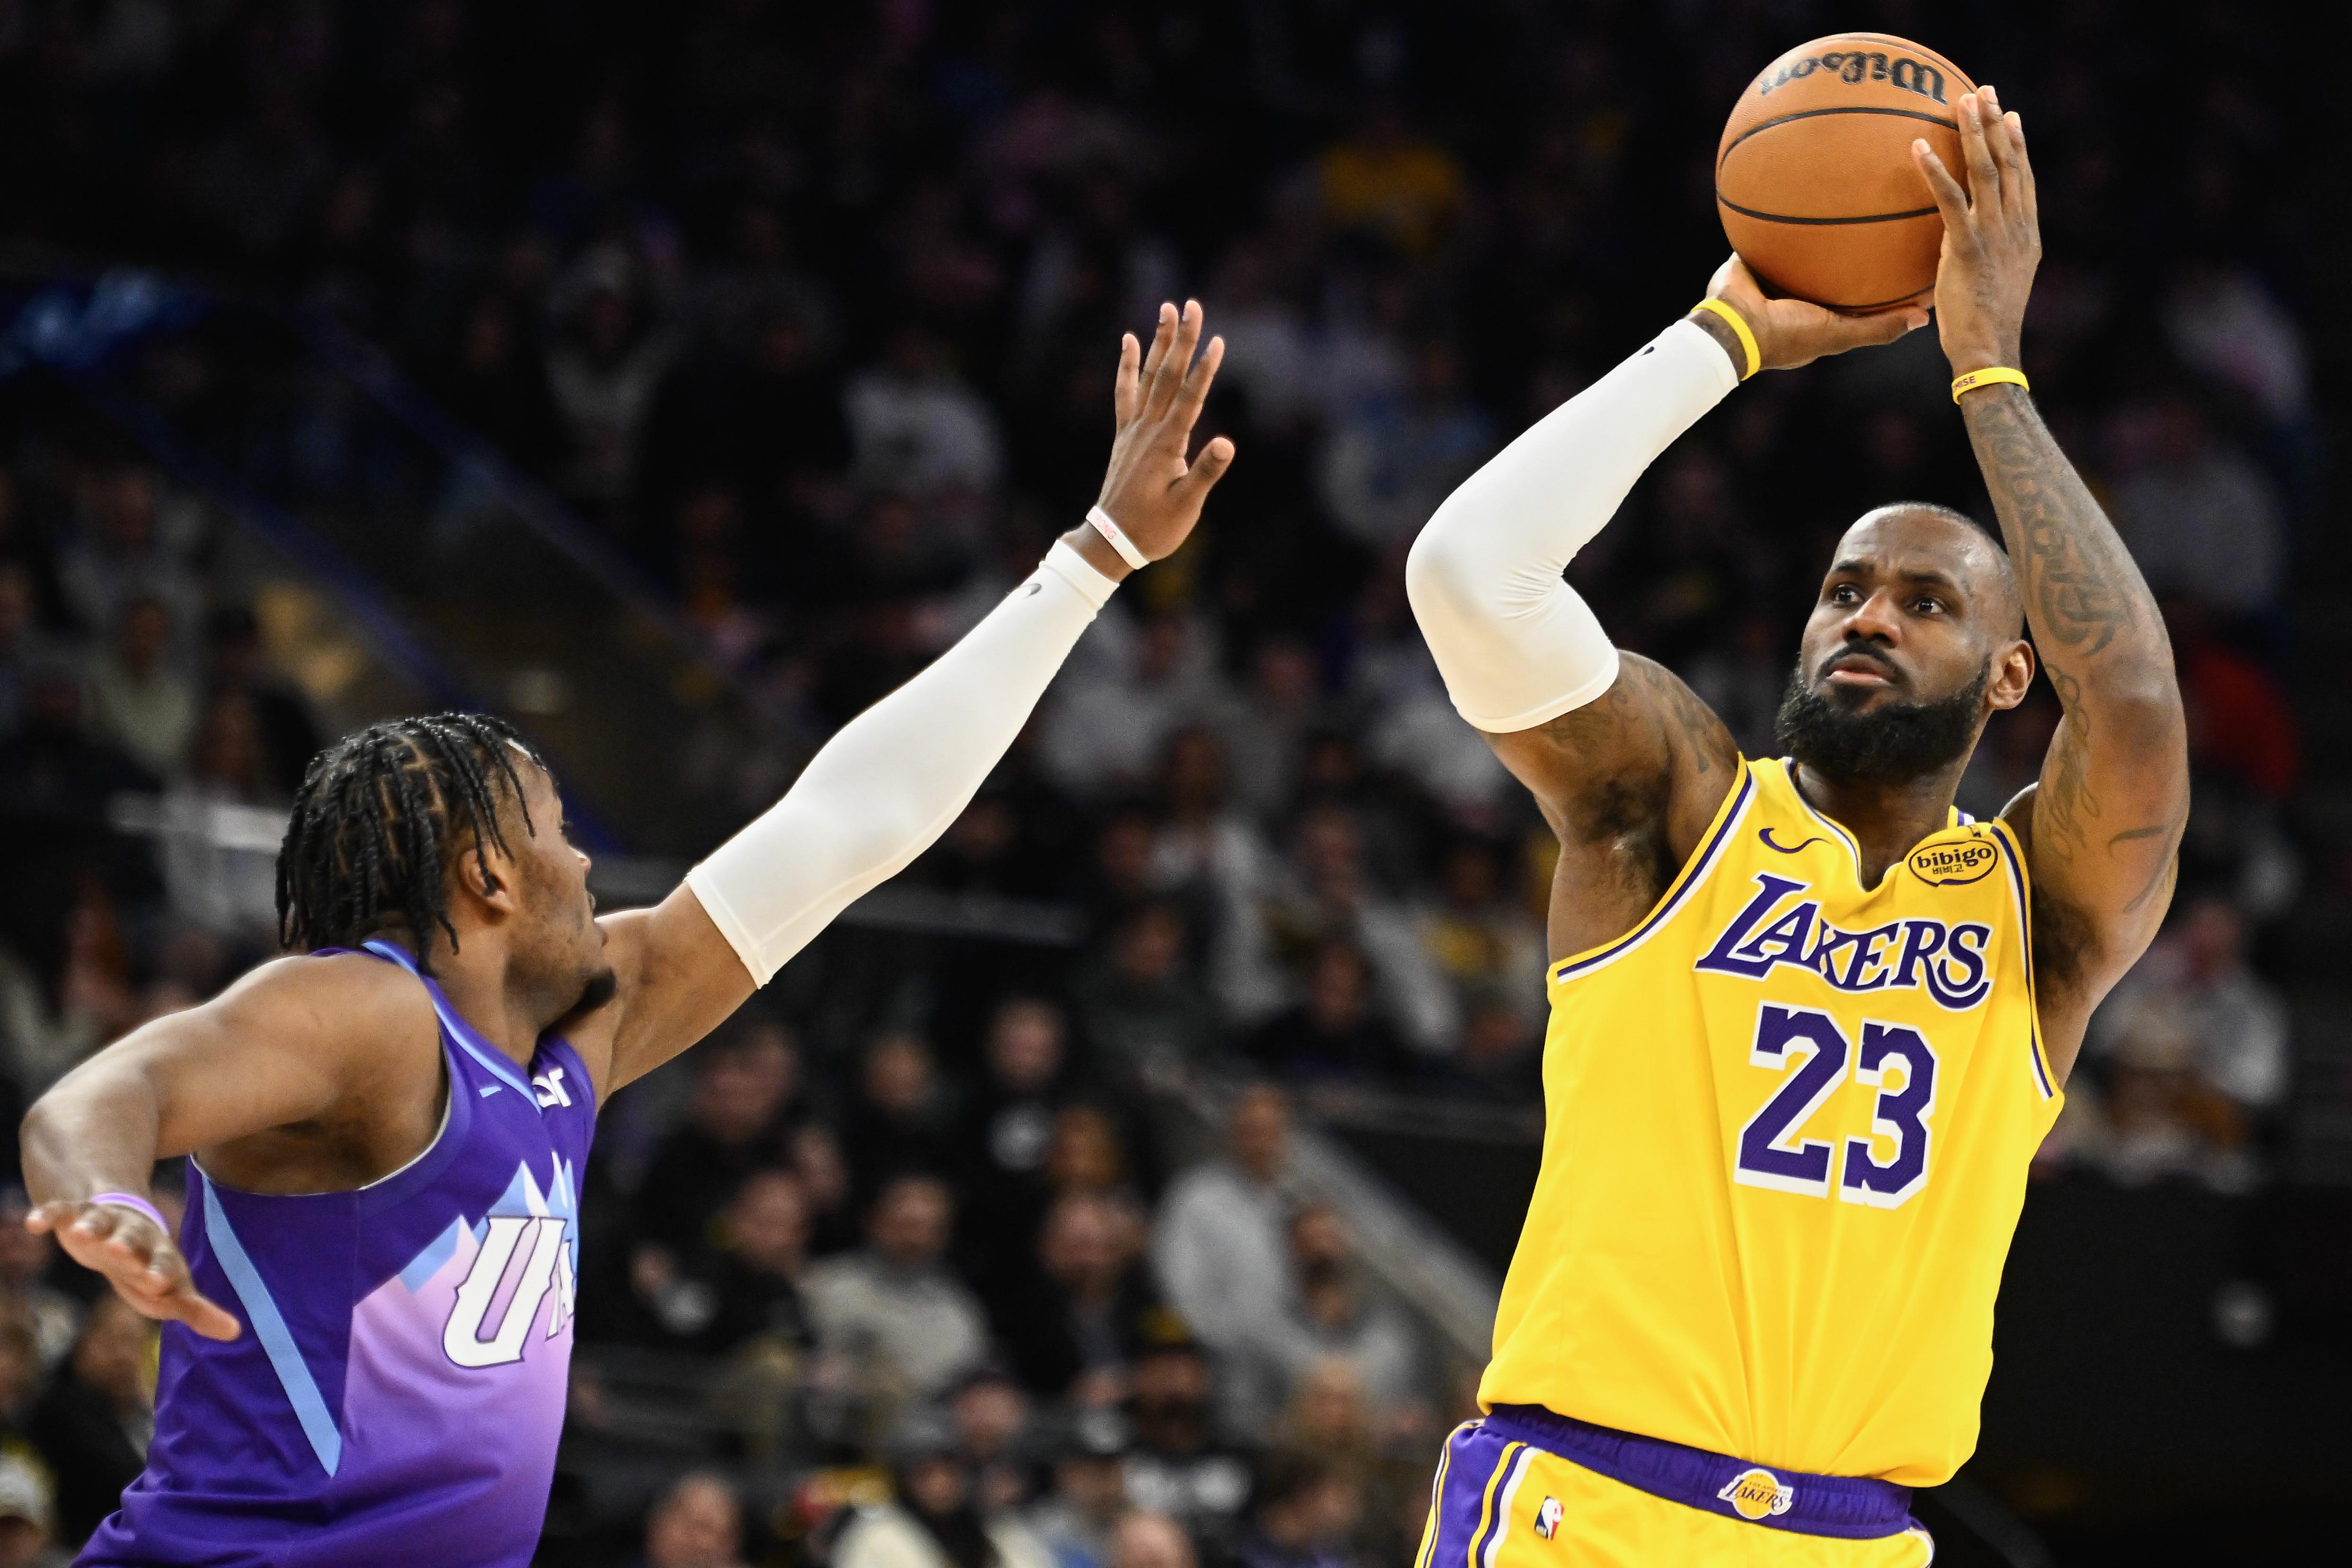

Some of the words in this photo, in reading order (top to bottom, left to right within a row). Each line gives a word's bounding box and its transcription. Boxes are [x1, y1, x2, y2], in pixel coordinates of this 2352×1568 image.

[1760, 51, 1948, 107] Wilson
[1917, 847, 1992, 868] bibigo
[1932, 864, 1964, 875] 비비고
[1692, 871, 1993, 1012] LAKERS
[1733, 1000, 1940, 1210] 23
[1720, 1478, 1791, 1514] LAKERS
